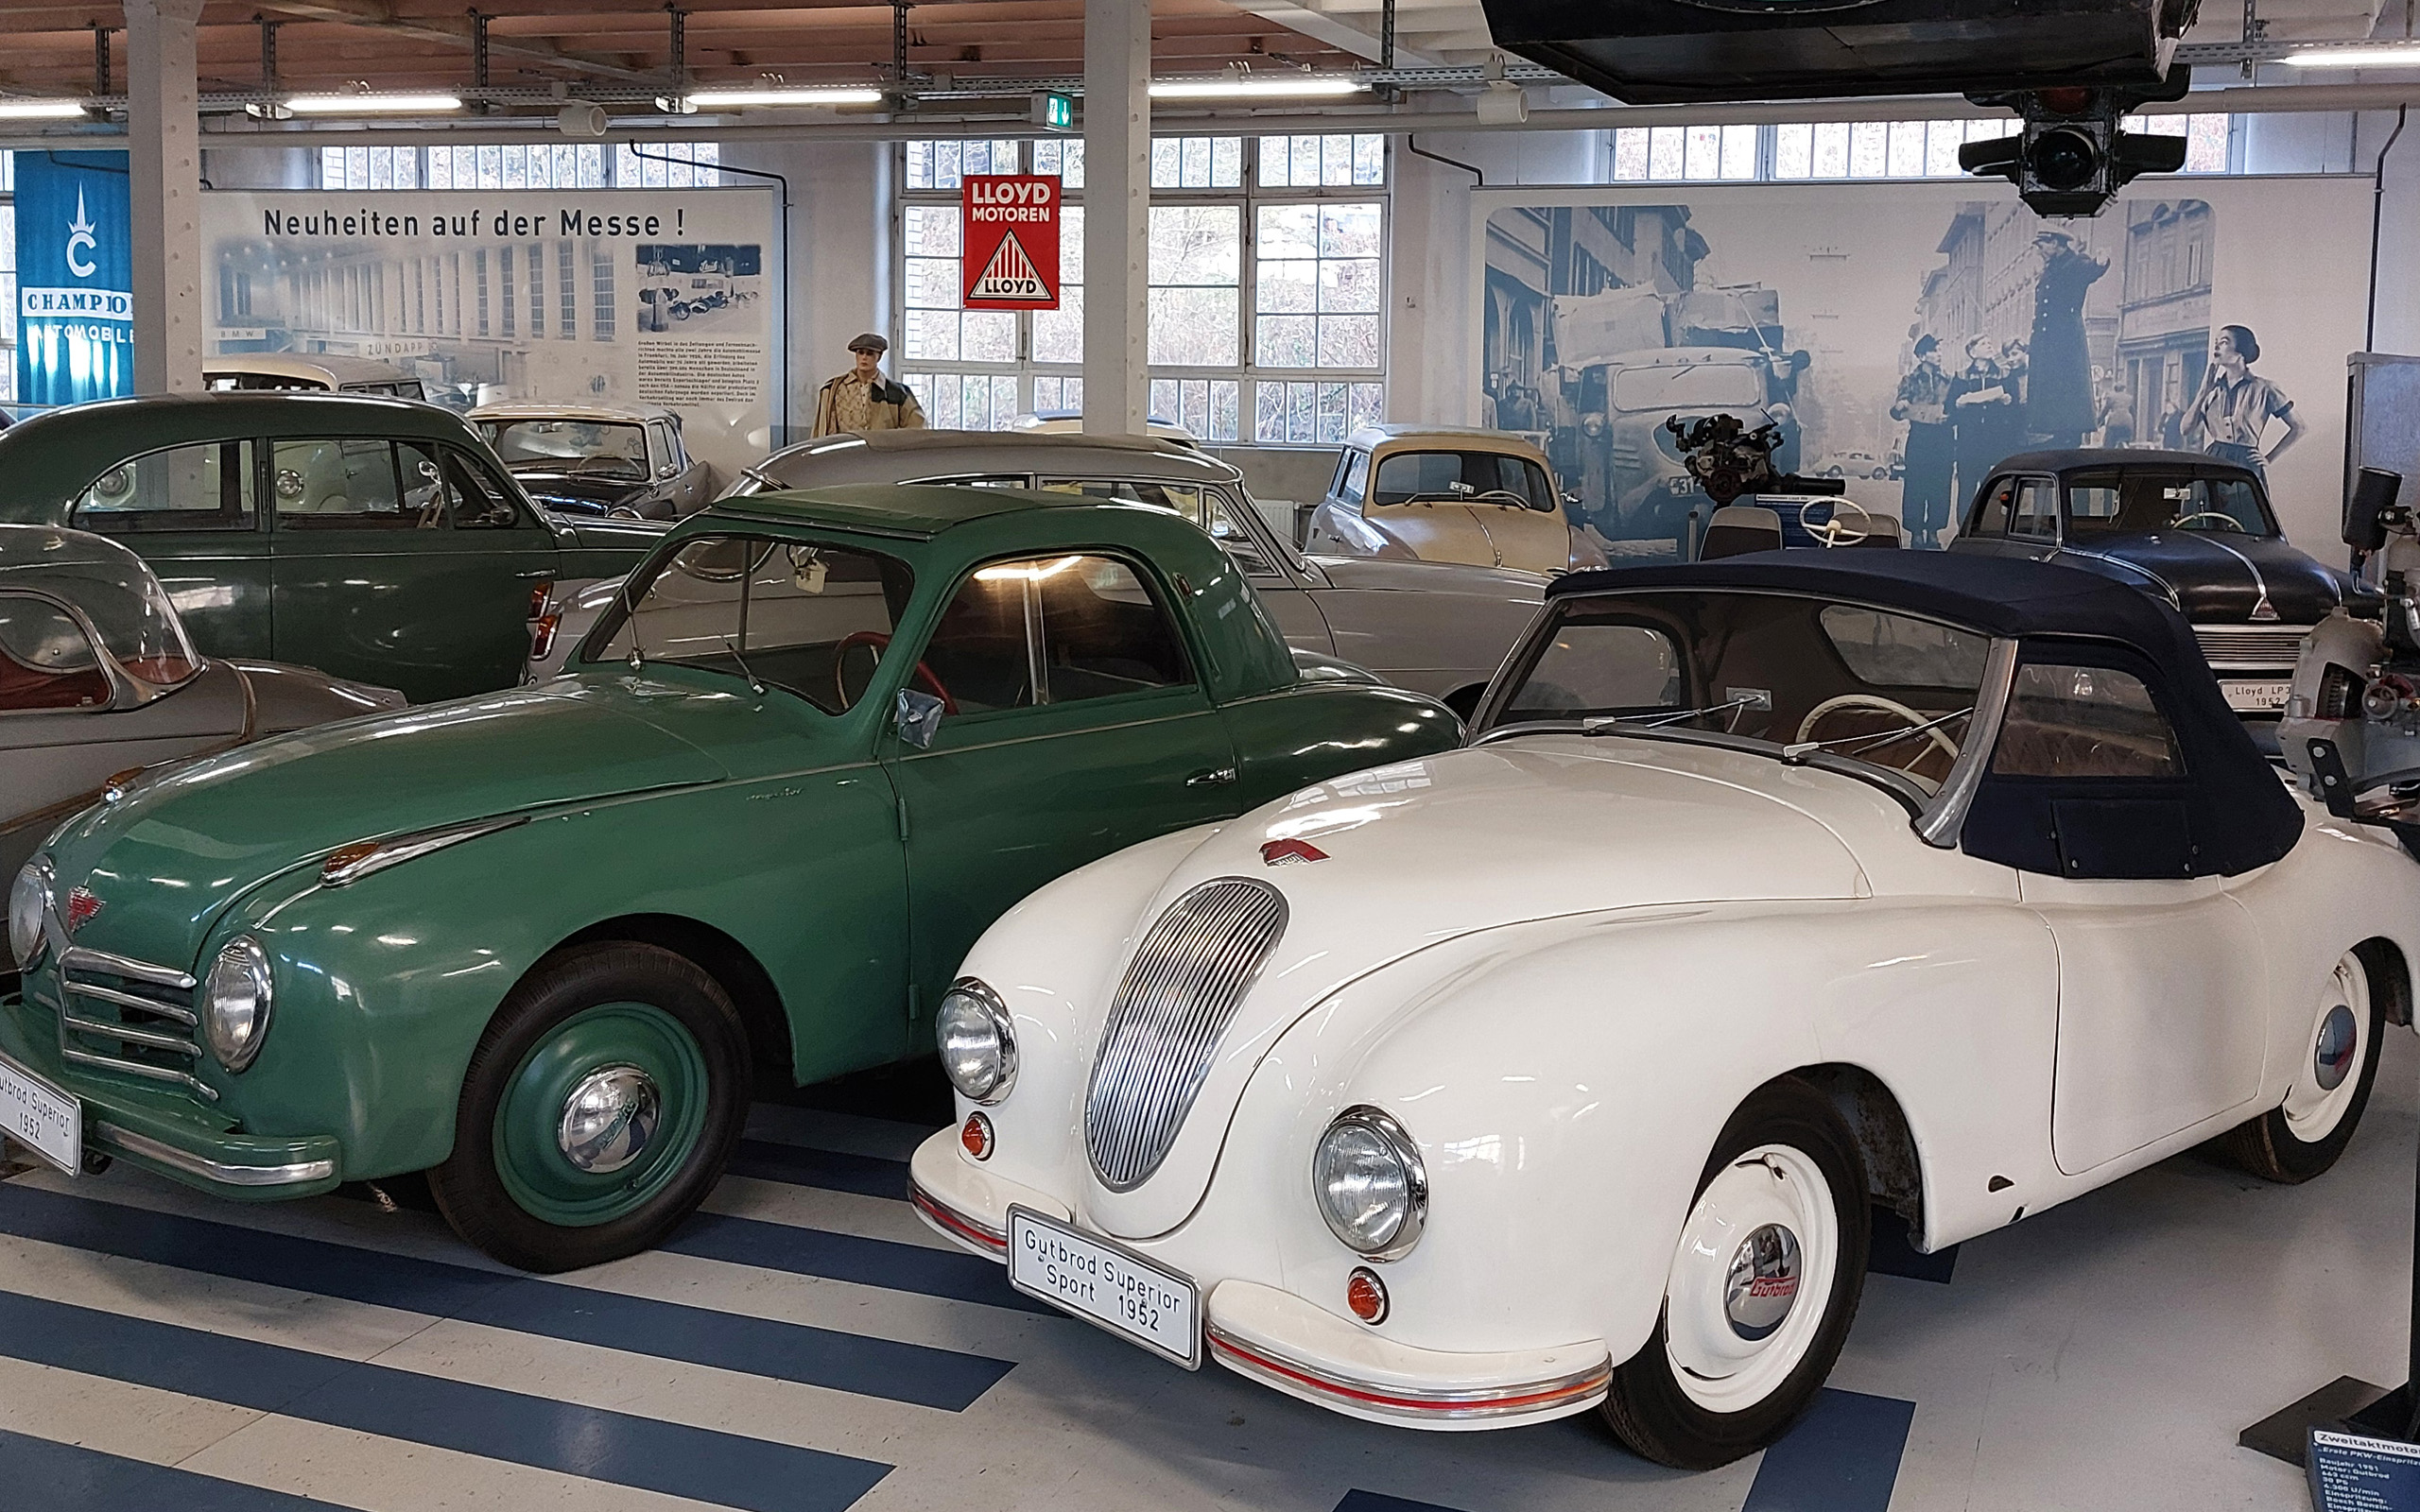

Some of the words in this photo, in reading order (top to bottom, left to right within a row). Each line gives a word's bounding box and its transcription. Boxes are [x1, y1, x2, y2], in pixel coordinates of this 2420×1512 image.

[972, 182, 1051, 204] LLOYD
[972, 207, 1050, 222] MOTOREN
[264, 210, 418, 235] Neuheiten
[433, 210, 480, 236] auf
[493, 210, 545, 236] der
[561, 210, 660, 236] Messe
[676, 209, 684, 235] !
[984, 279, 1037, 294] LLOYD
[368, 341, 424, 356] ZÜNDAPP
[2236, 687, 2263, 696] Lloyd
[2256, 697, 2281, 706] 1952
[0, 1075, 27, 1105] utbrod
[31, 1092, 71, 1130] Superior
[19, 1112, 40, 1141] 1952
[1025, 1229, 1097, 1276] Gutbrod
[1104, 1262, 1181, 1314] Superior
[1046, 1264, 1096, 1303] Sport
[1118, 1295, 1159, 1332] 1952
[2319, 1434, 2420, 1454] Zweitaktmoto
[2319, 1457, 2355, 1468] Baujahr
[2350, 1451, 2420, 1467] PKW-Einspritz
[2320, 1464, 2351, 1474] Motor:
[2352, 1469, 2390, 1480] Gutbrod
[2325, 1489, 2388, 1504] Einspritzung:
[2350, 1486, 2380, 1497] U/min
[2325, 1496, 2355, 1505] Bosch
